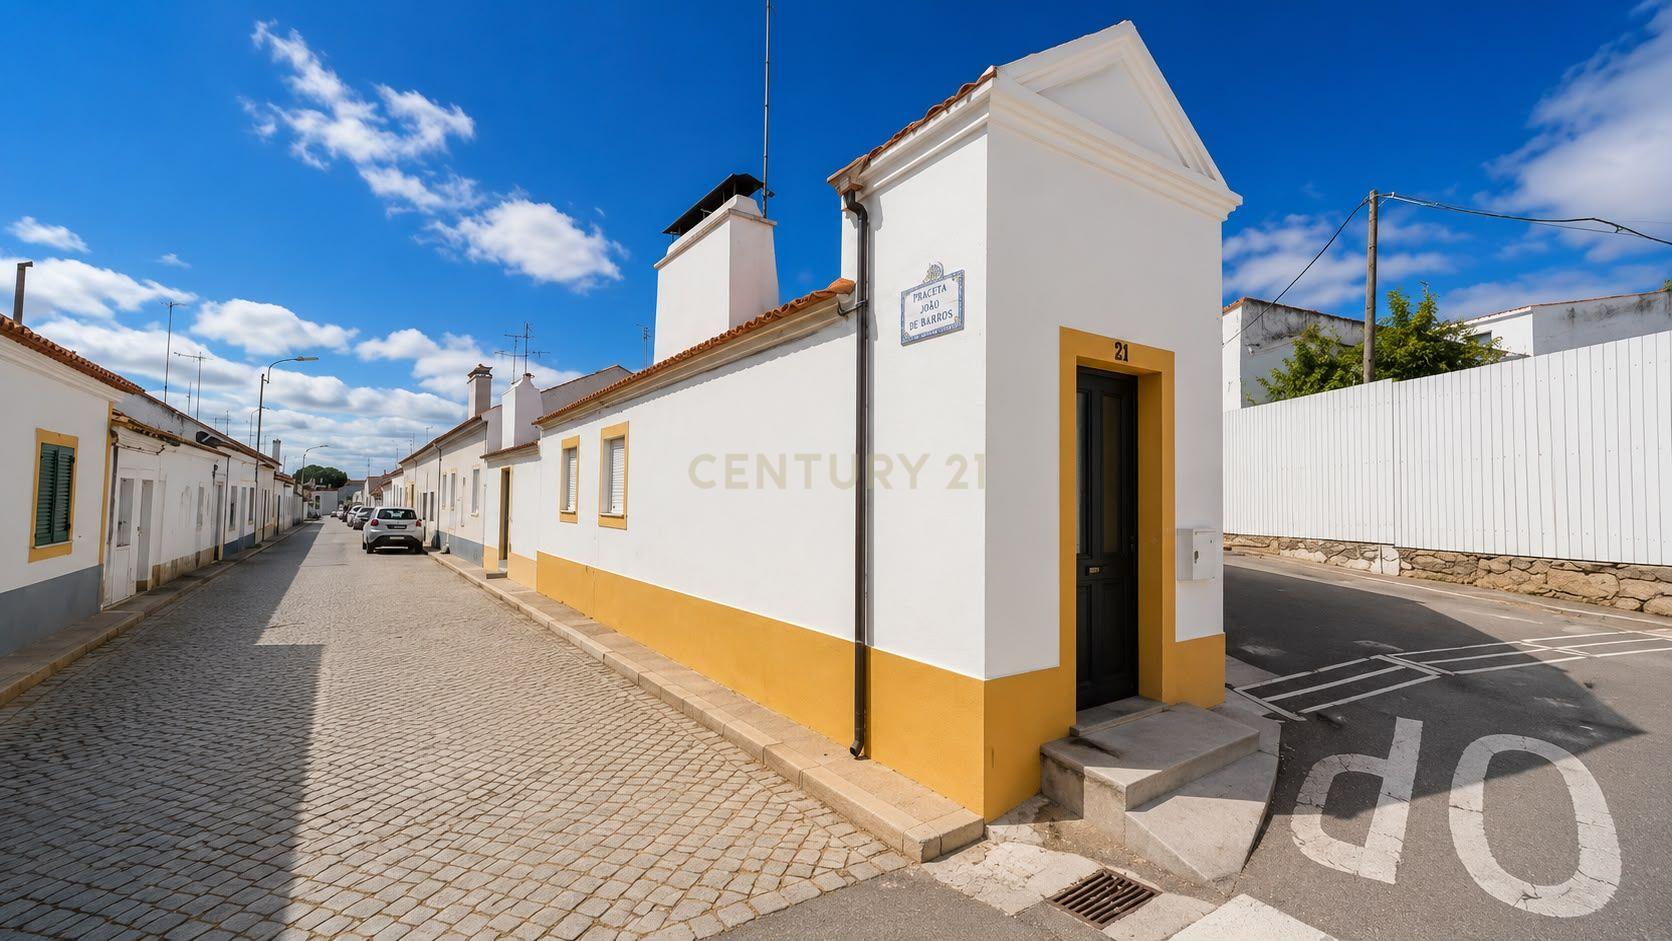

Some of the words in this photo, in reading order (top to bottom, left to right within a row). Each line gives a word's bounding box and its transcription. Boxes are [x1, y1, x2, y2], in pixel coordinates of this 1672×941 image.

[912, 283, 947, 303] PRACETA
[920, 299, 940, 314] JOÃO
[909, 319, 919, 331] DE
[920, 309, 953, 327] BARROS
[1114, 341, 1129, 362] 21
